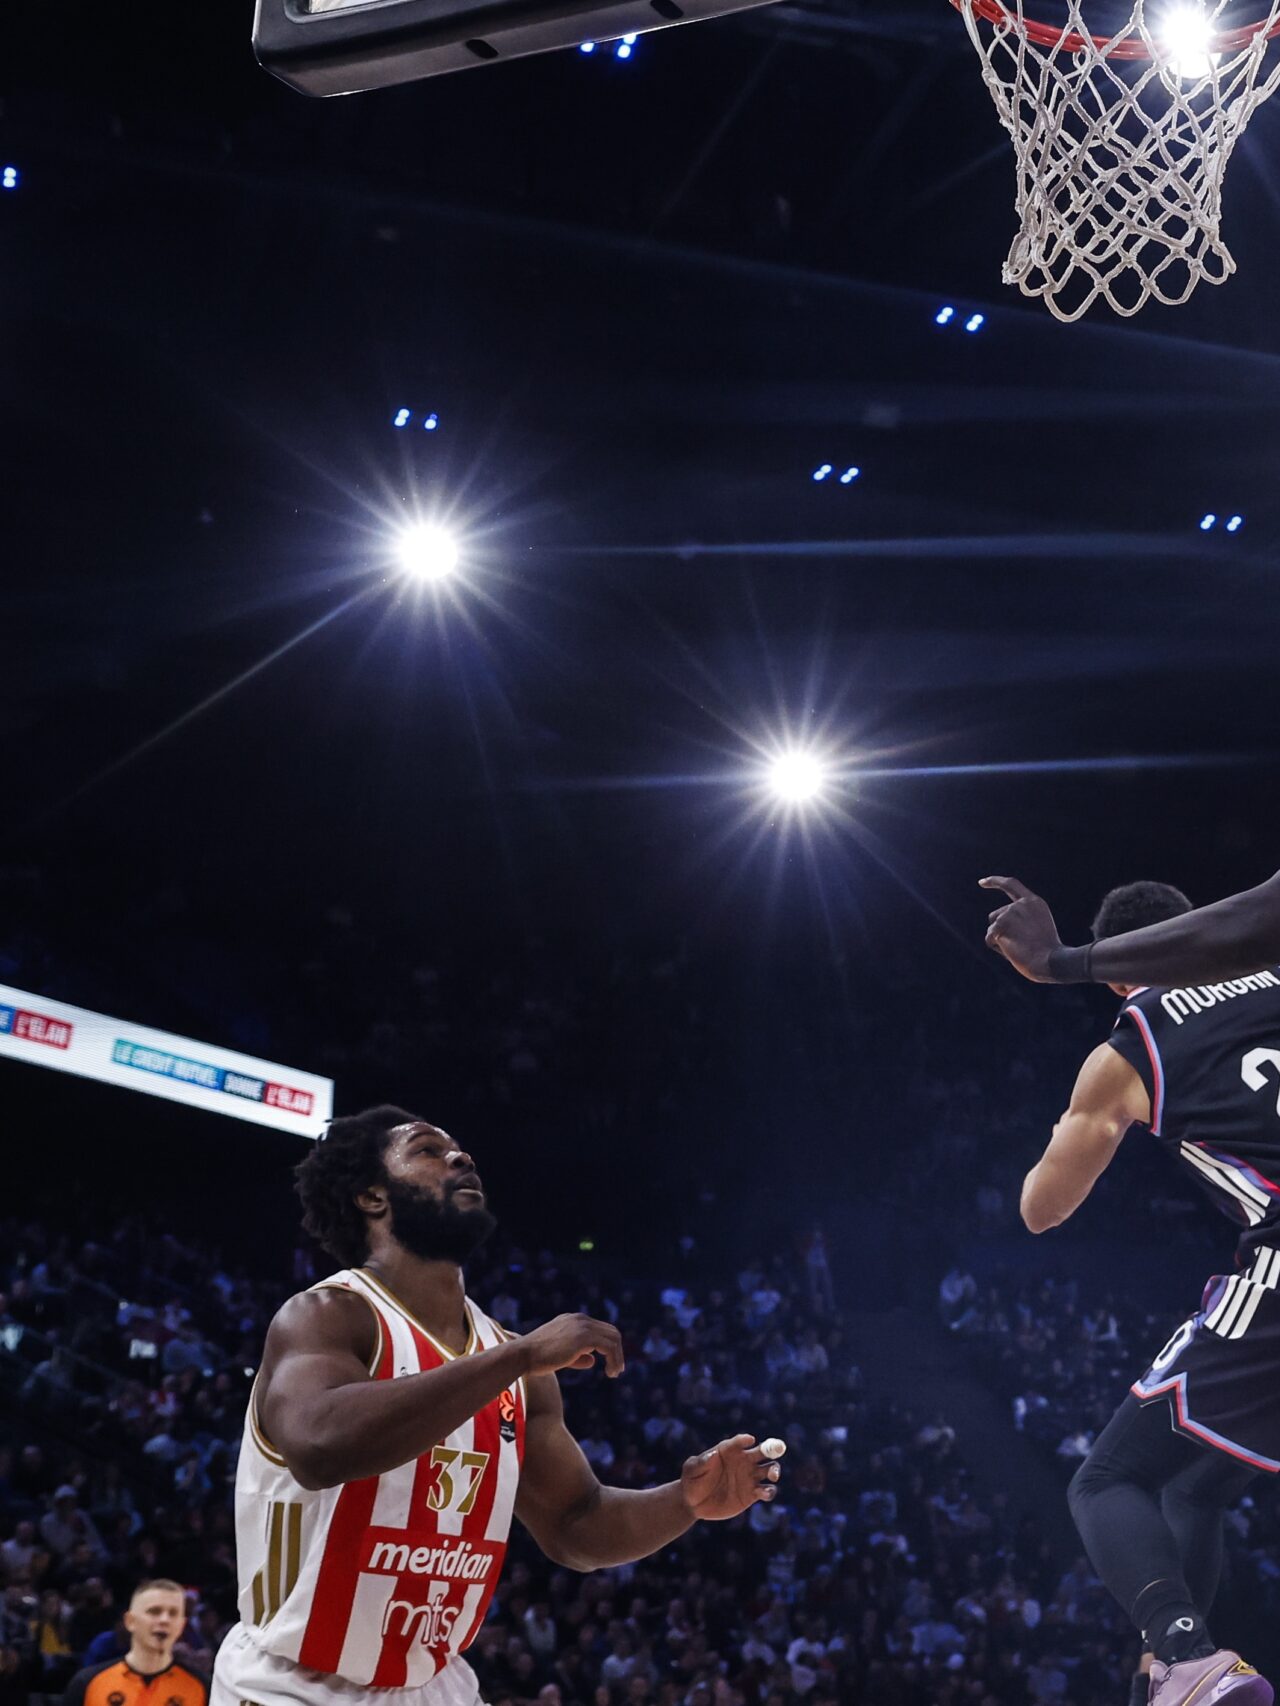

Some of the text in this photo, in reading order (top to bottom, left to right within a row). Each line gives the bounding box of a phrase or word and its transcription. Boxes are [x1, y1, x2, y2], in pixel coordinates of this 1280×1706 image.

[426, 1445, 491, 1516] 37
[368, 1541, 494, 1580] meridian
[381, 1593, 460, 1648] mts
